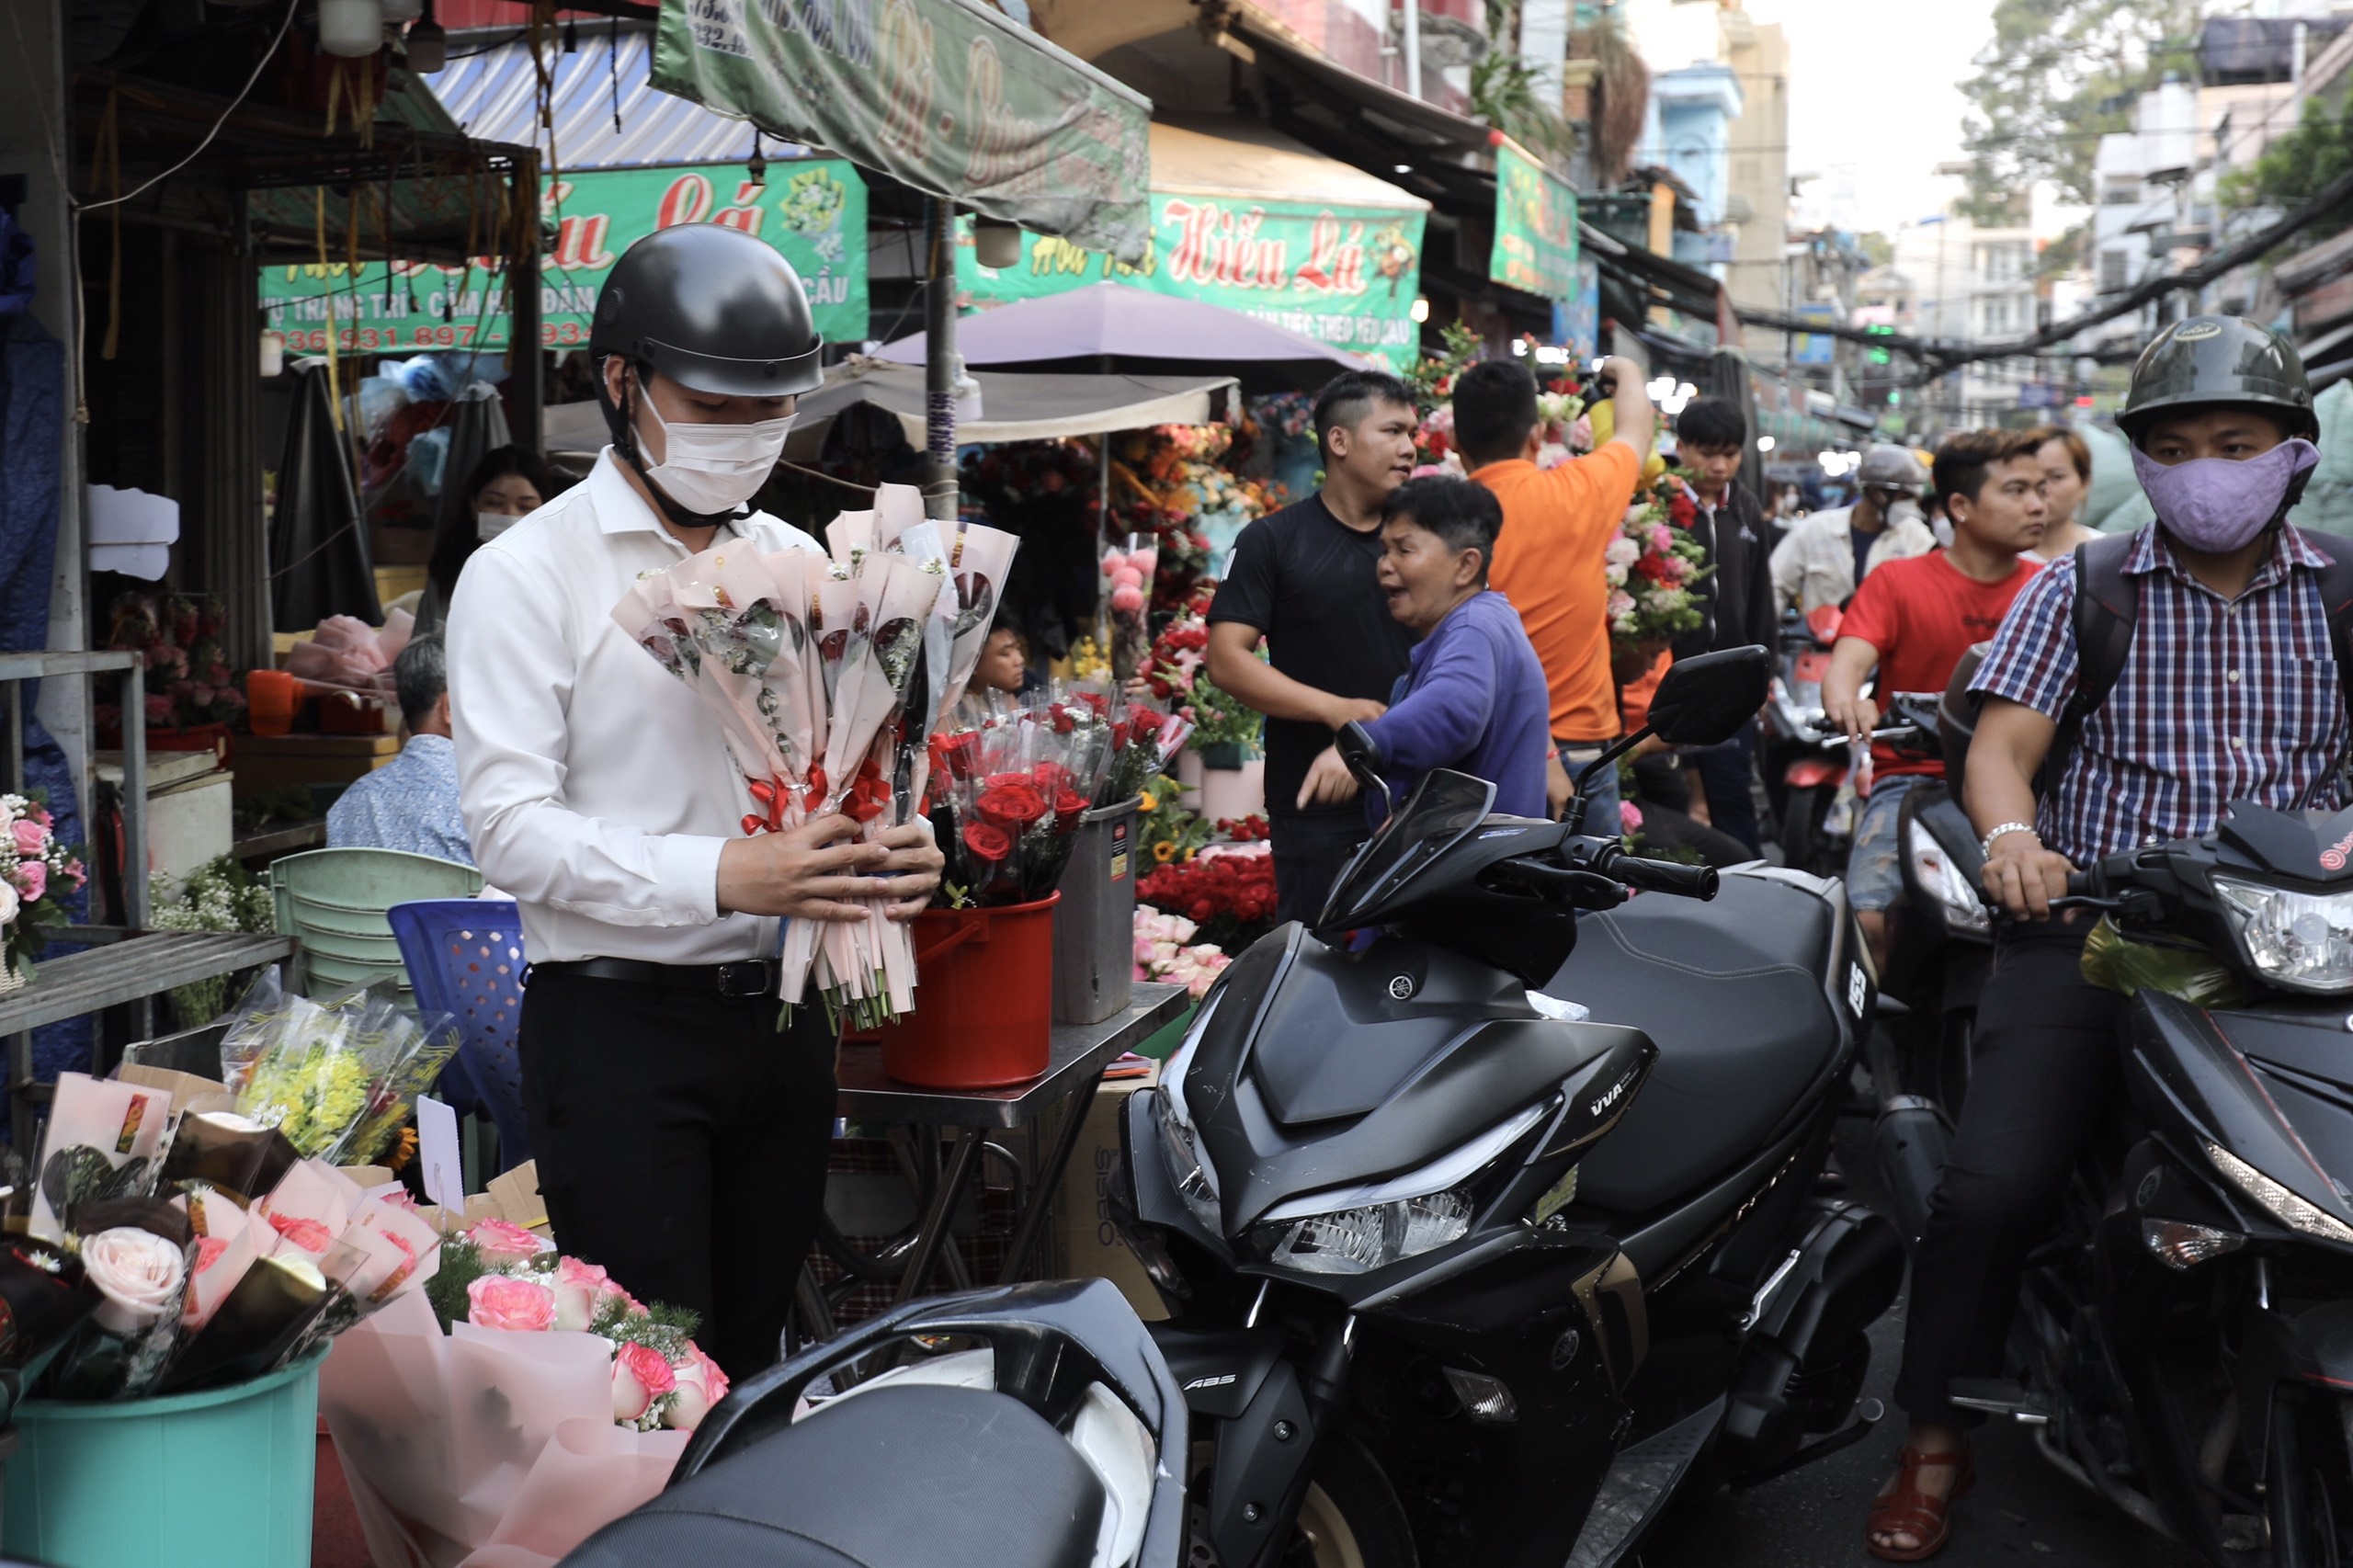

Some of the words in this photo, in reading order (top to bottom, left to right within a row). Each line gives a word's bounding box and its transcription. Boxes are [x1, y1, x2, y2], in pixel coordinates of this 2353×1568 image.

[1847, 960, 1868, 1019] 155
[1590, 1082, 1623, 1118] VVA
[1182, 1373, 1237, 1392] ABS
